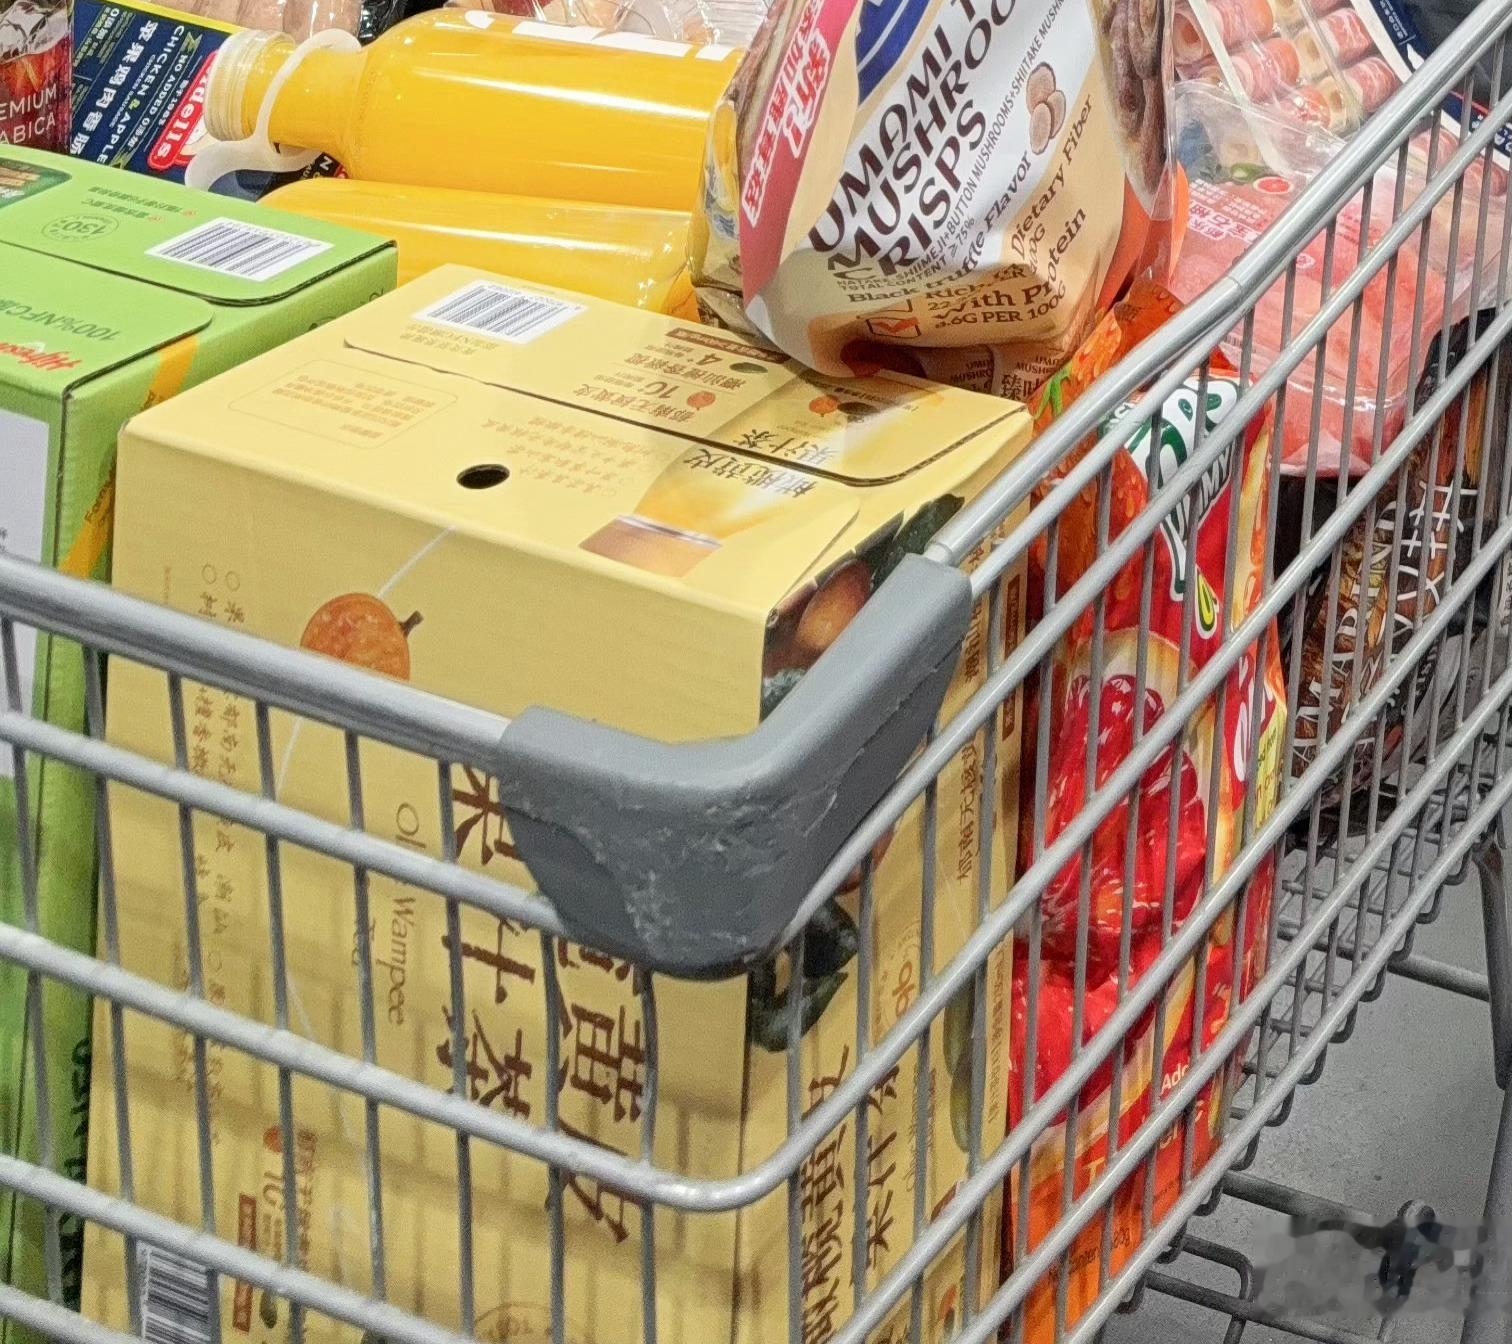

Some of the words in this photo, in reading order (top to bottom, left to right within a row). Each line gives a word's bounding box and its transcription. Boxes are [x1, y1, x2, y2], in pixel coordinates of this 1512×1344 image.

[70, 20, 158, 155] 苹果鸡肉香肠
[136, 25, 185, 96] CHICKEN
[150, 74, 176, 115] ADDED
[97, 112, 131, 164] APPLE
[808, 24, 953, 252] UMAMI
[833, 99, 986, 280] CRISPS
[1012, 166, 1065, 260] Dietary
[1063, 94, 1092, 165] Fiber
[848, 286, 921, 304] Black
[984, 151, 1032, 233] Flavor
[1023, 208, 1087, 305] Protein
[981, 310, 1023, 324] PER
[1029, 283, 1067, 320] 100G
[734, 428, 837, 463] 果汁茶
[386, 896, 417, 1026] Wampee
